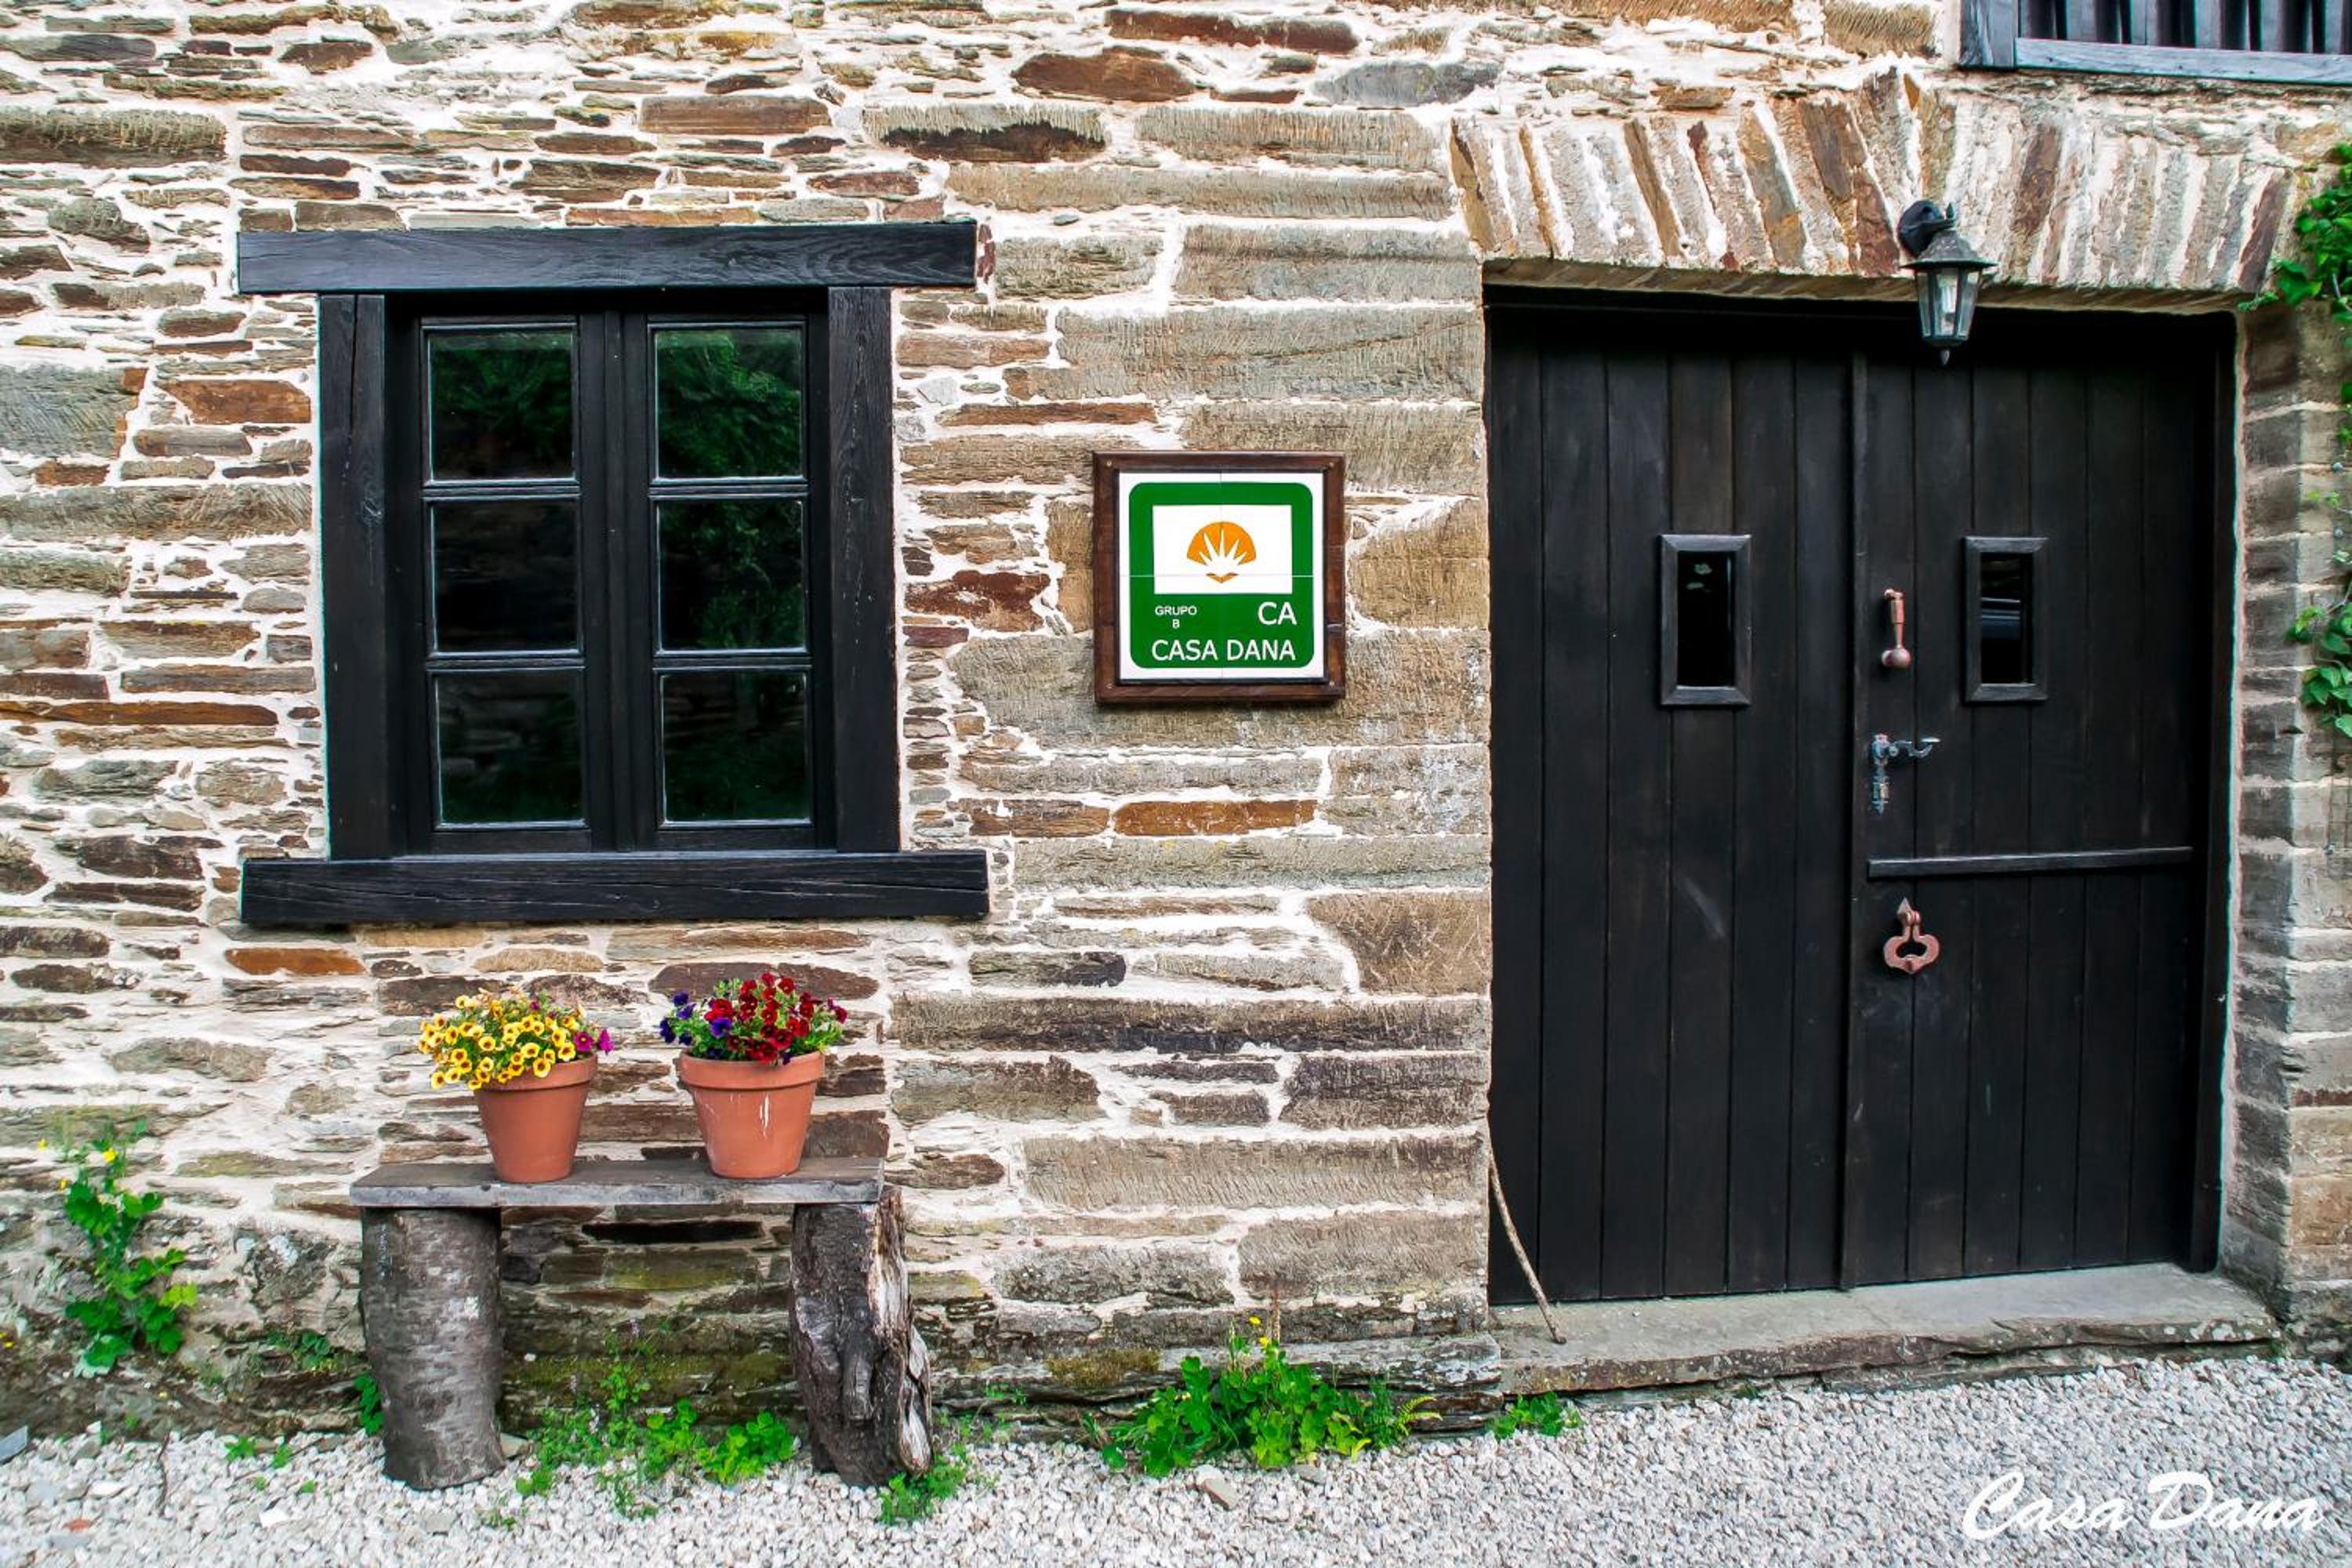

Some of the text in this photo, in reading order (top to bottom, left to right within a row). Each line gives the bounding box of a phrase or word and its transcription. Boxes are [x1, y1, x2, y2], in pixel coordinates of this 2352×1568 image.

[1155, 605, 1197, 615] GRUPO
[1258, 601, 1298, 626] CA
[1172, 619, 1180, 628] B
[1152, 639, 1296, 661] CASA DANA
